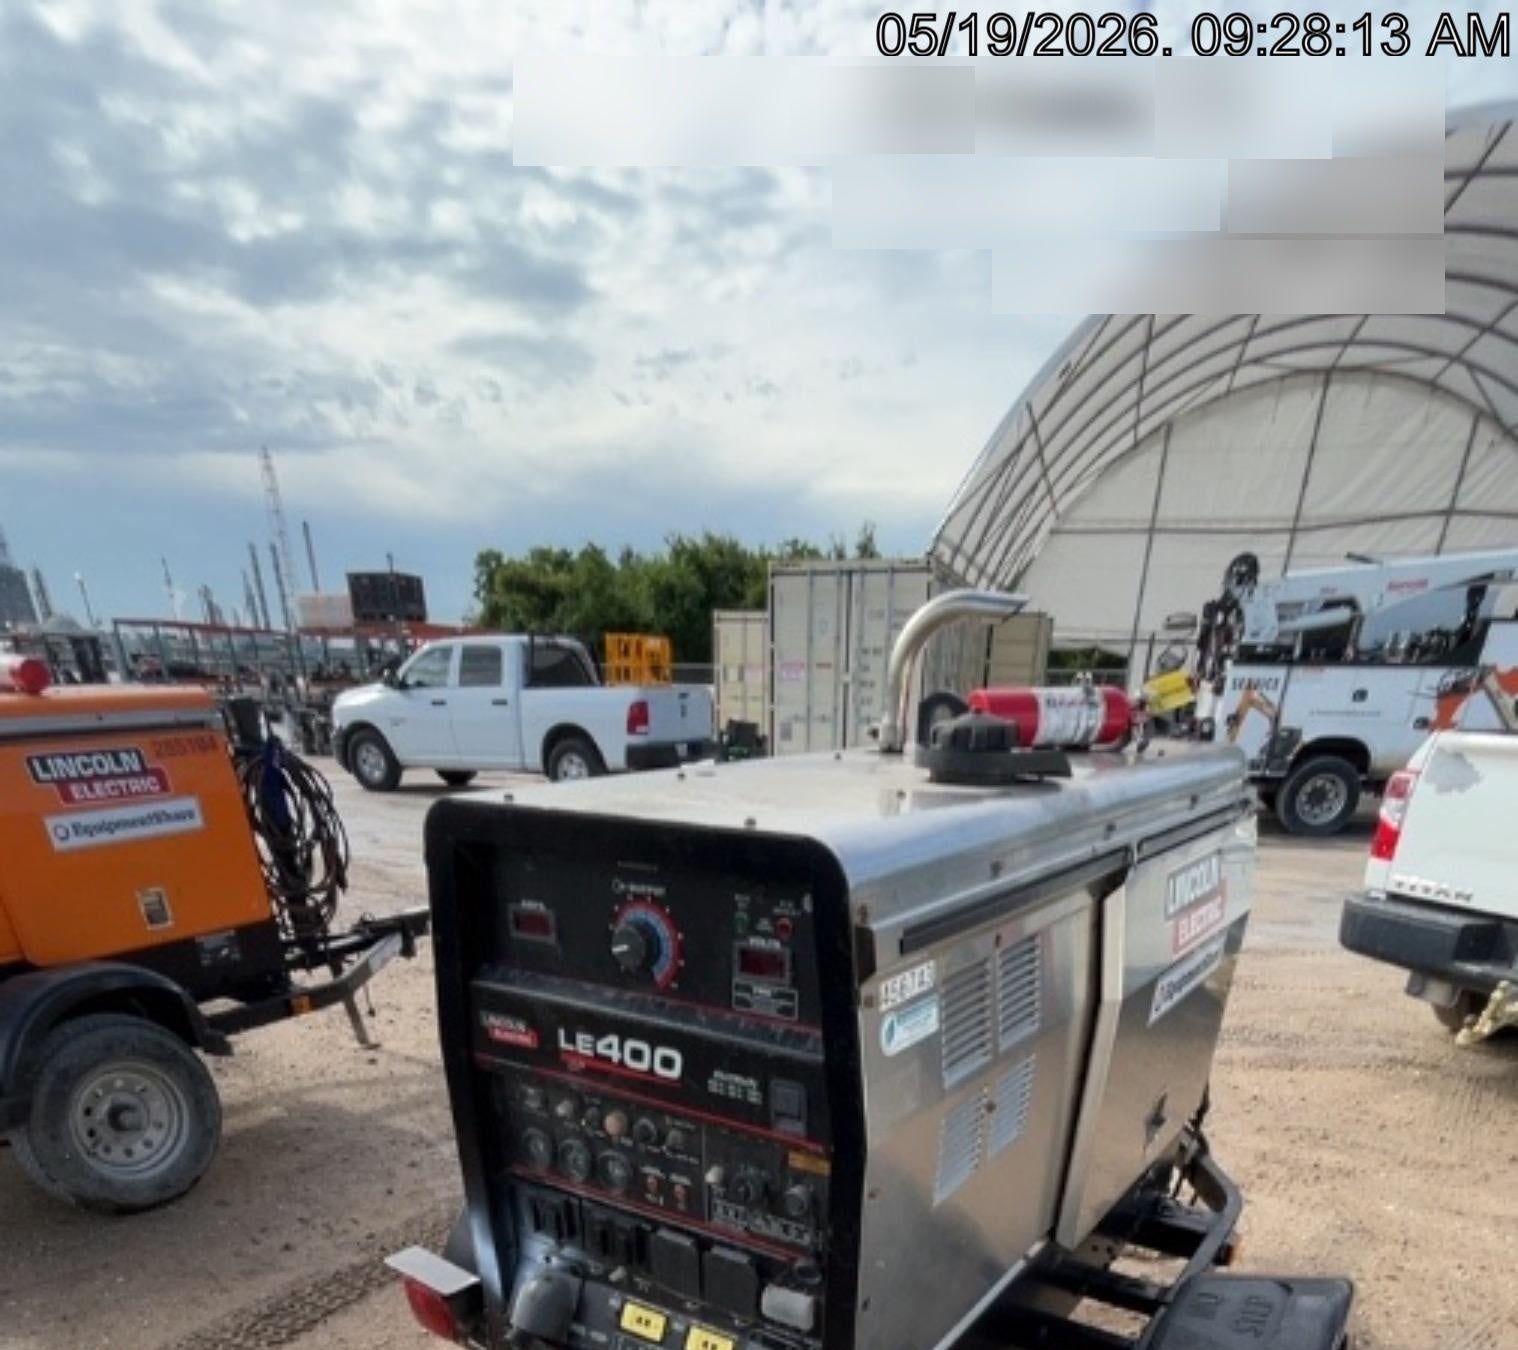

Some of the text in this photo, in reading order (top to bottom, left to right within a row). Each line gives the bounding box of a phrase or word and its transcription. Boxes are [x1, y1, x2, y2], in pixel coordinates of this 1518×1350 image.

[1232, 677, 1280, 691] SERVICE
[32, 751, 141, 781] LINCOLN
[69, 775, 160, 801] ELECTRIC
[1394, 879, 1474, 904] TITAN
[557, 1027, 683, 1080] LE400
